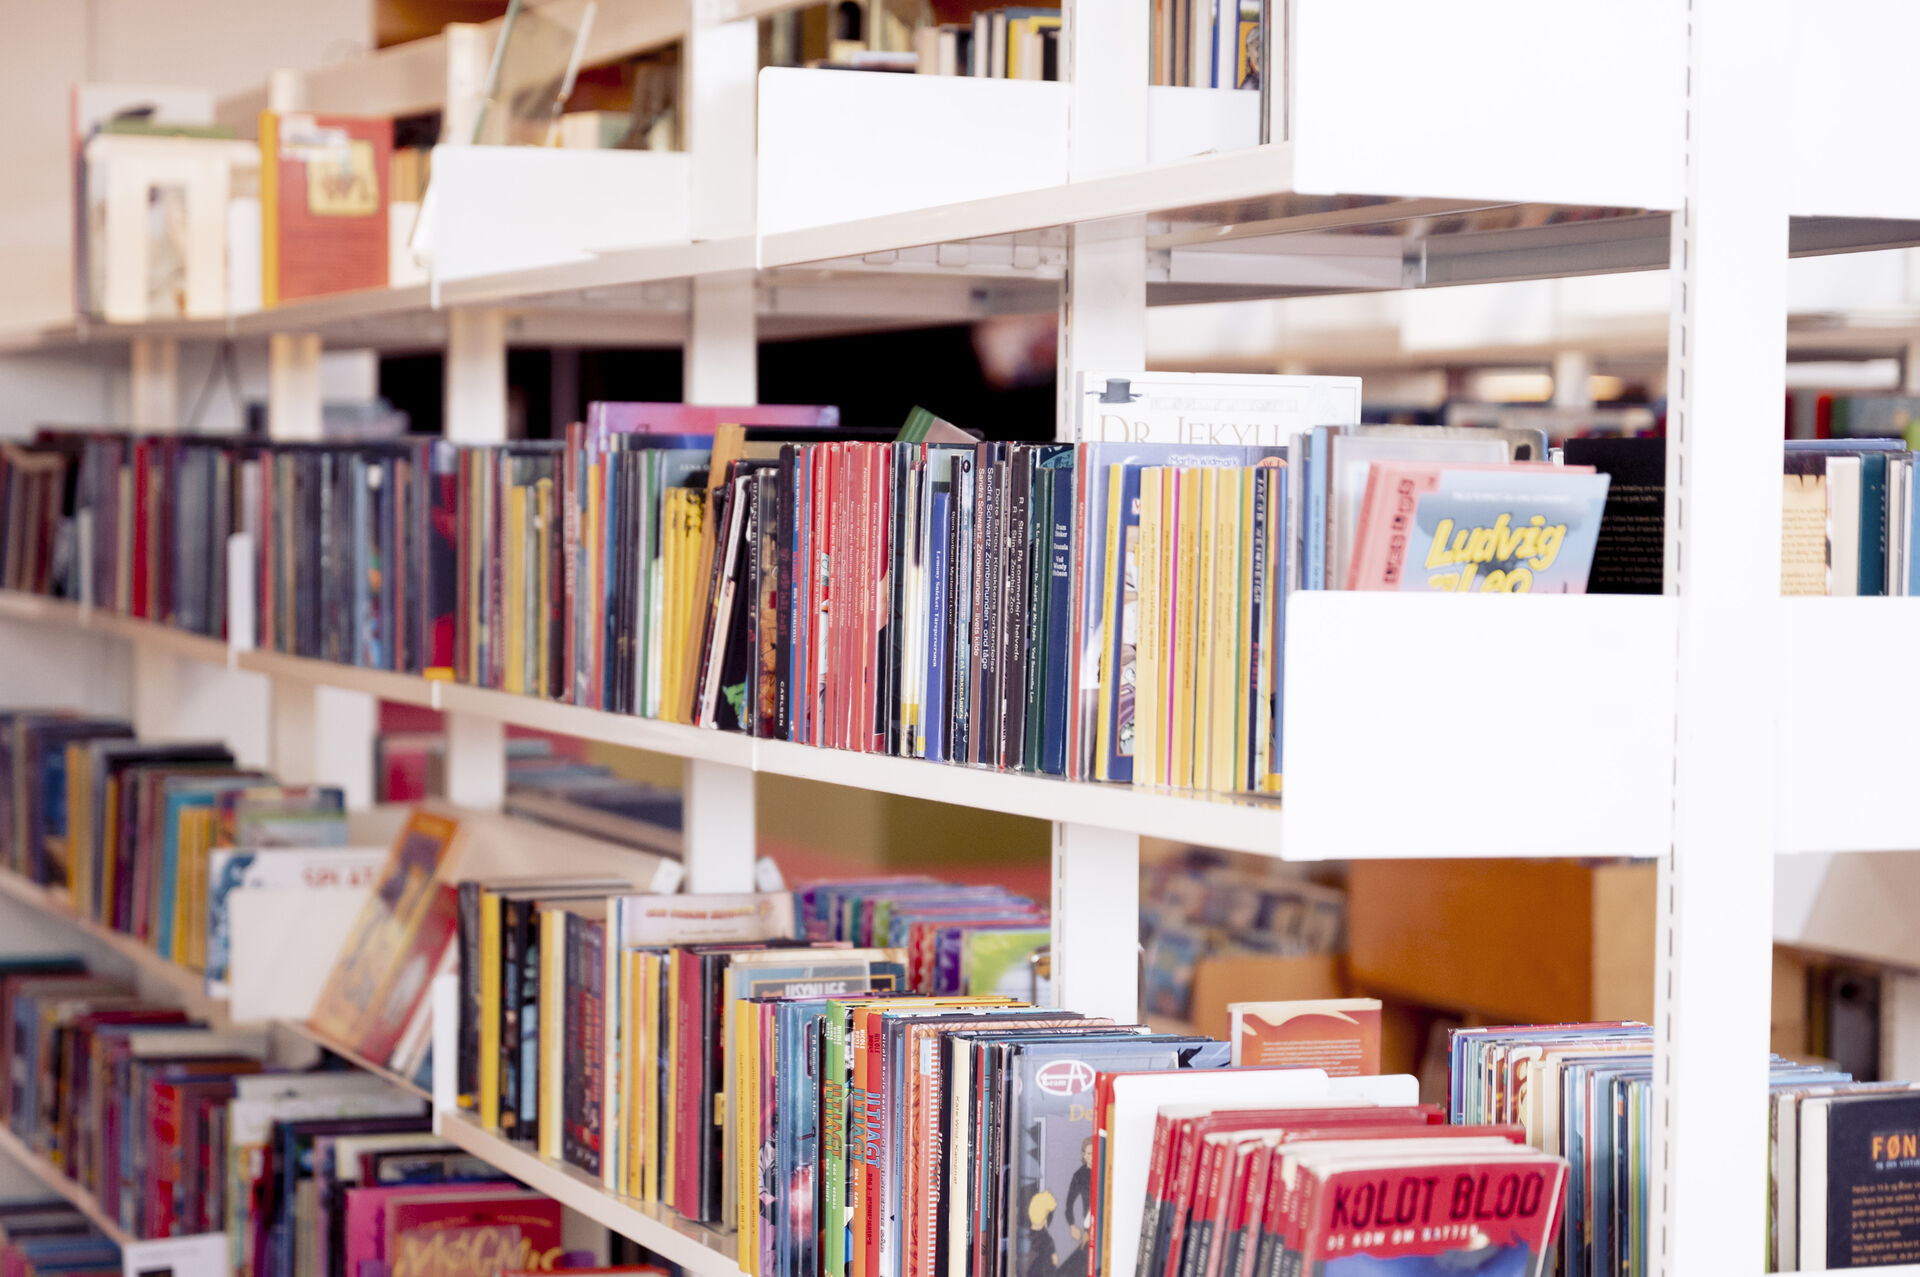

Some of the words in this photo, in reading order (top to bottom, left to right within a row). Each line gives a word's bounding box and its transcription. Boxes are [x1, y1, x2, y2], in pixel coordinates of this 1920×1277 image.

[986, 467, 994, 501] Sandra
[1169, 456, 1198, 466] Martin
[1200, 456, 1238, 466] Widmark
[985, 504, 993, 550] Schwartz:
[1424, 512, 1566, 572] Ludvig
[974, 544, 984, 606] Zombiehunden
[1017, 550, 1024, 561] På
[983, 552, 992, 621] Zombiehunden
[981, 649, 990, 670] tåge
[866, 1092, 880, 1168] ILTJAGT
[1450, 1172, 1544, 1221] BLOD
[1353, 1230, 1385, 1248] KOM
[1392, 1228, 1415, 1245] OM
